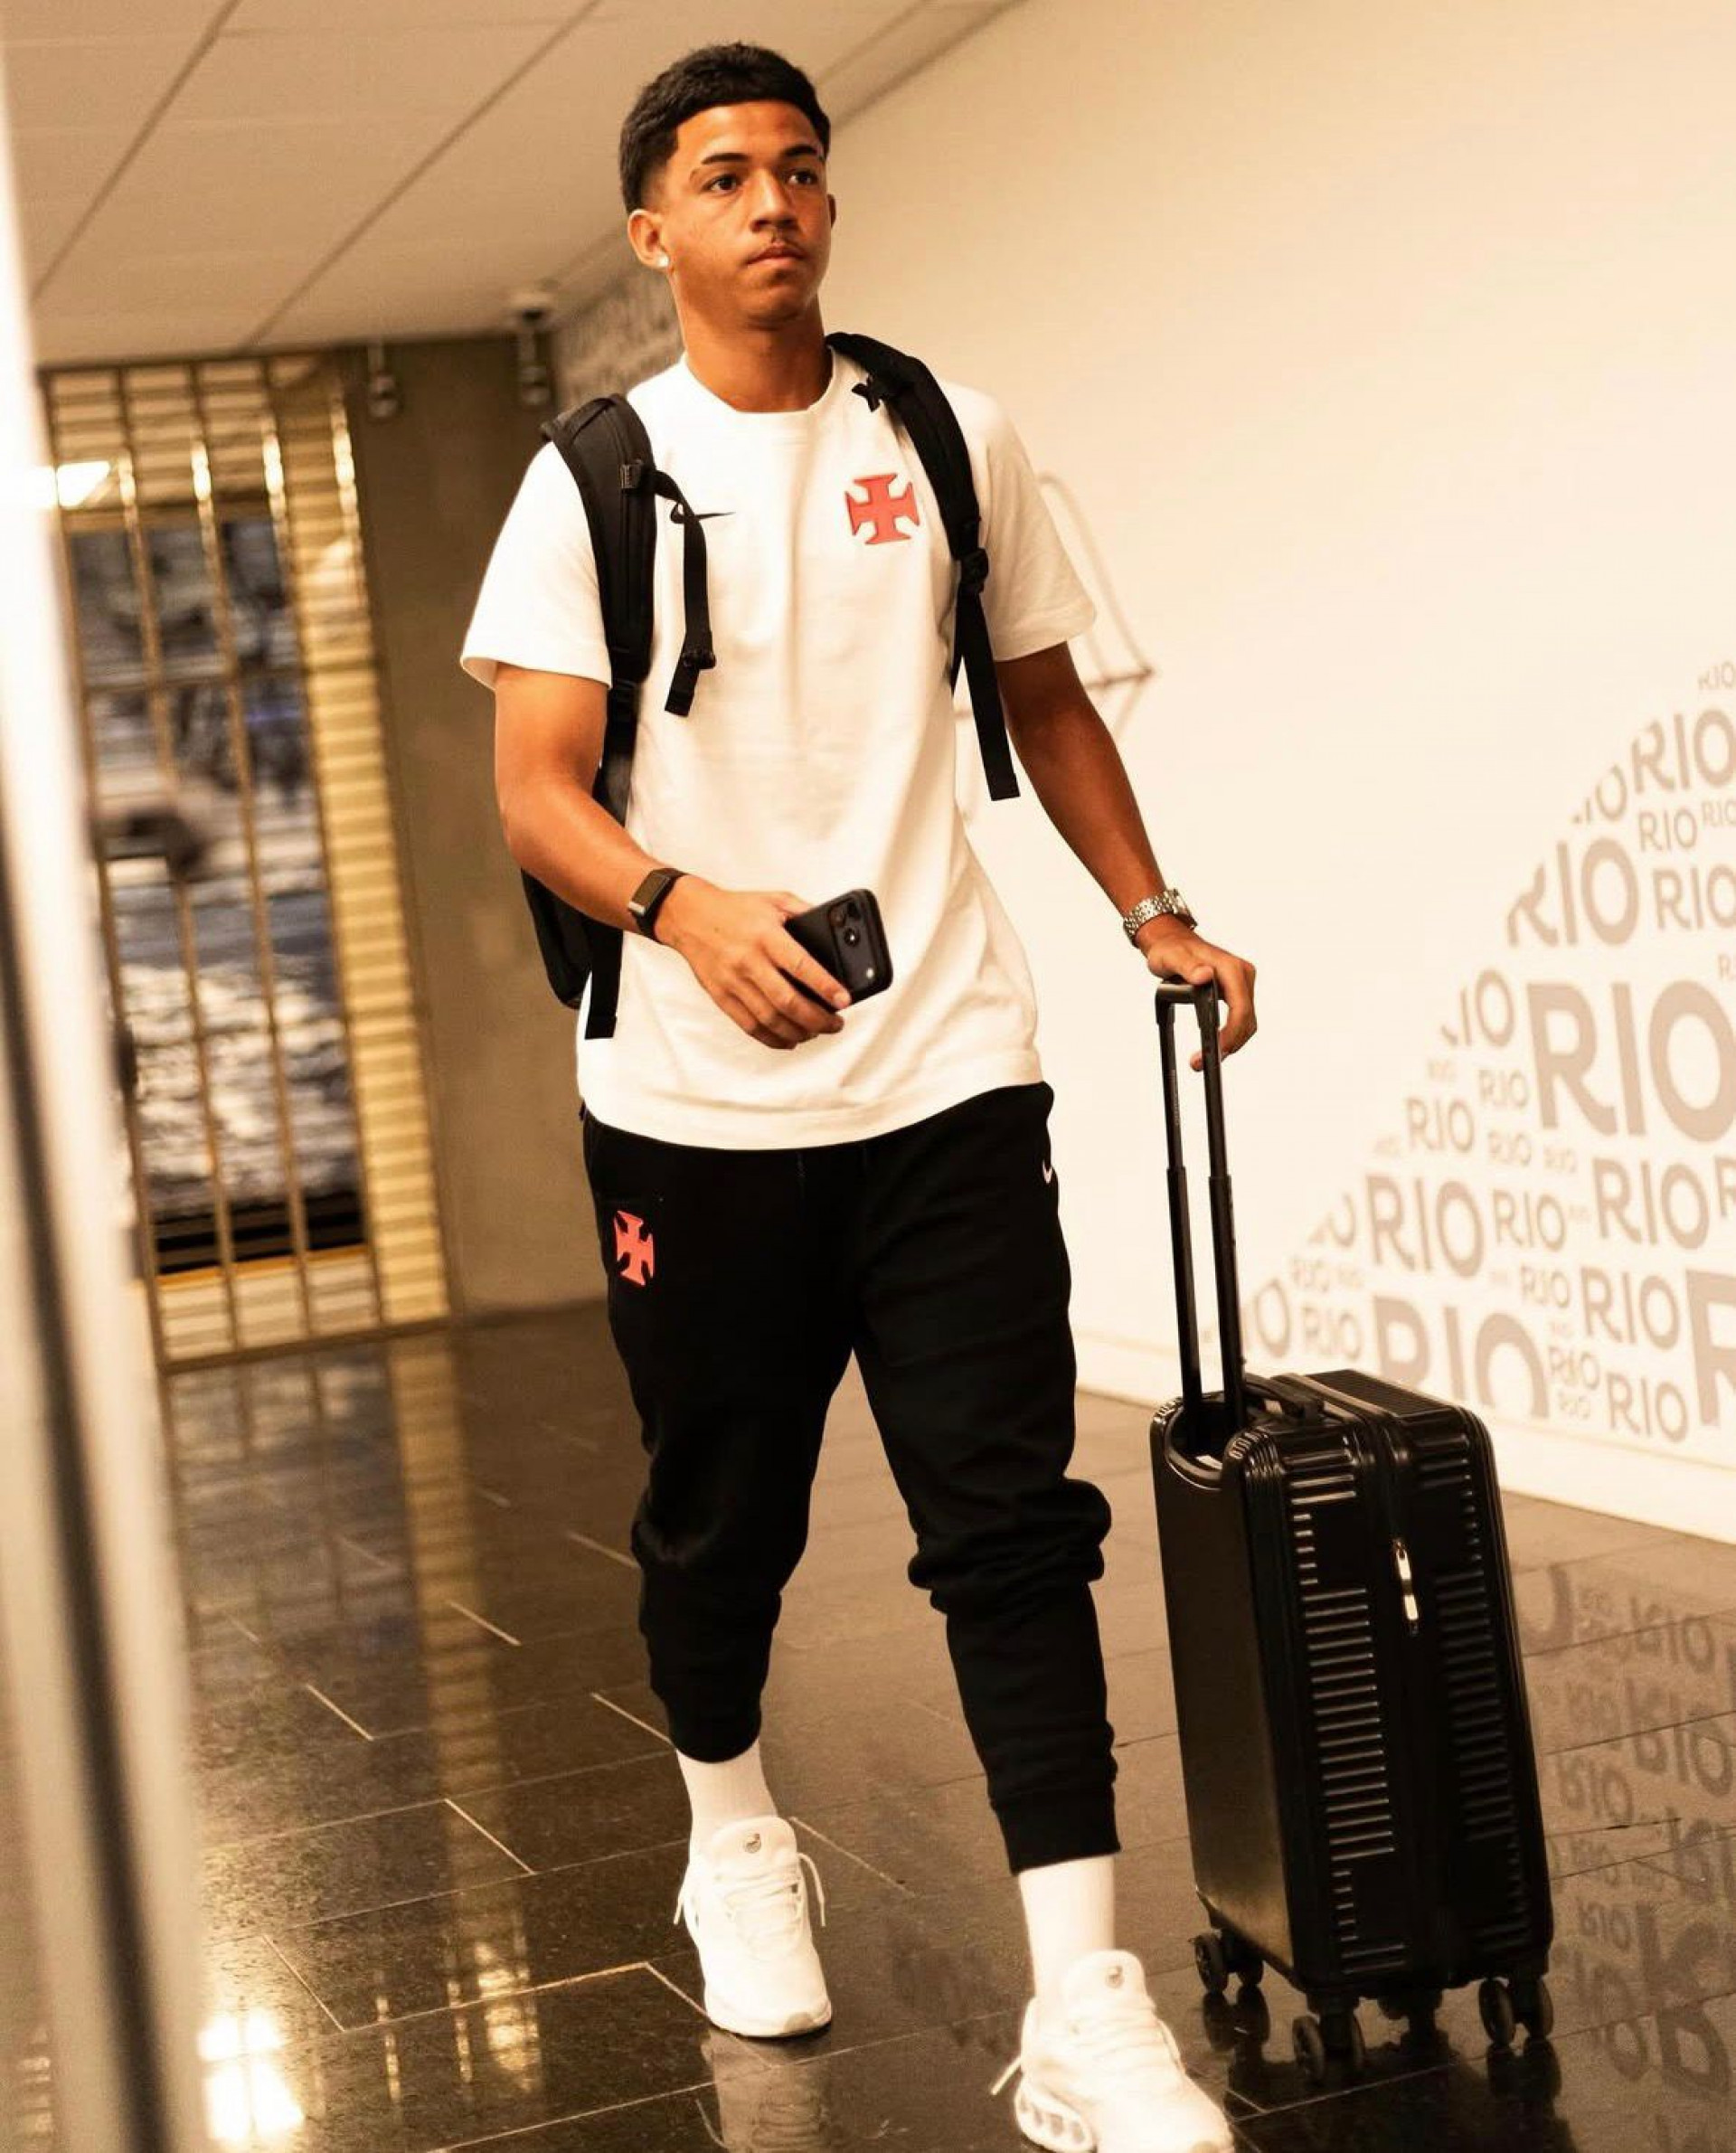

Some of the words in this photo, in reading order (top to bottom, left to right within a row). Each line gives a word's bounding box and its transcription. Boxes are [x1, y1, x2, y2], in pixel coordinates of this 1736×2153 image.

[1630, 708, 1736, 795] RIO
[1638, 807, 1697, 852] RIO
[1653, 864, 1736, 930] RIO
[1439, 969, 1515, 1047] IO
[1477, 1068, 1530, 1110] RIO
[1525, 980, 1736, 1141] RIO
[1403, 1096, 1475, 1154] RIO
[1363, 1173, 1484, 1279] RIO
[1492, 1188, 1568, 1251] RIO
[1593, 1157, 1711, 1250] RIO
[1520, 1264, 1571, 1309] RIO
[1580, 1267, 1680, 1350] RIO
[1545, 1345, 1600, 1391] RIO
[1606, 1371, 1689, 1444] RIO
